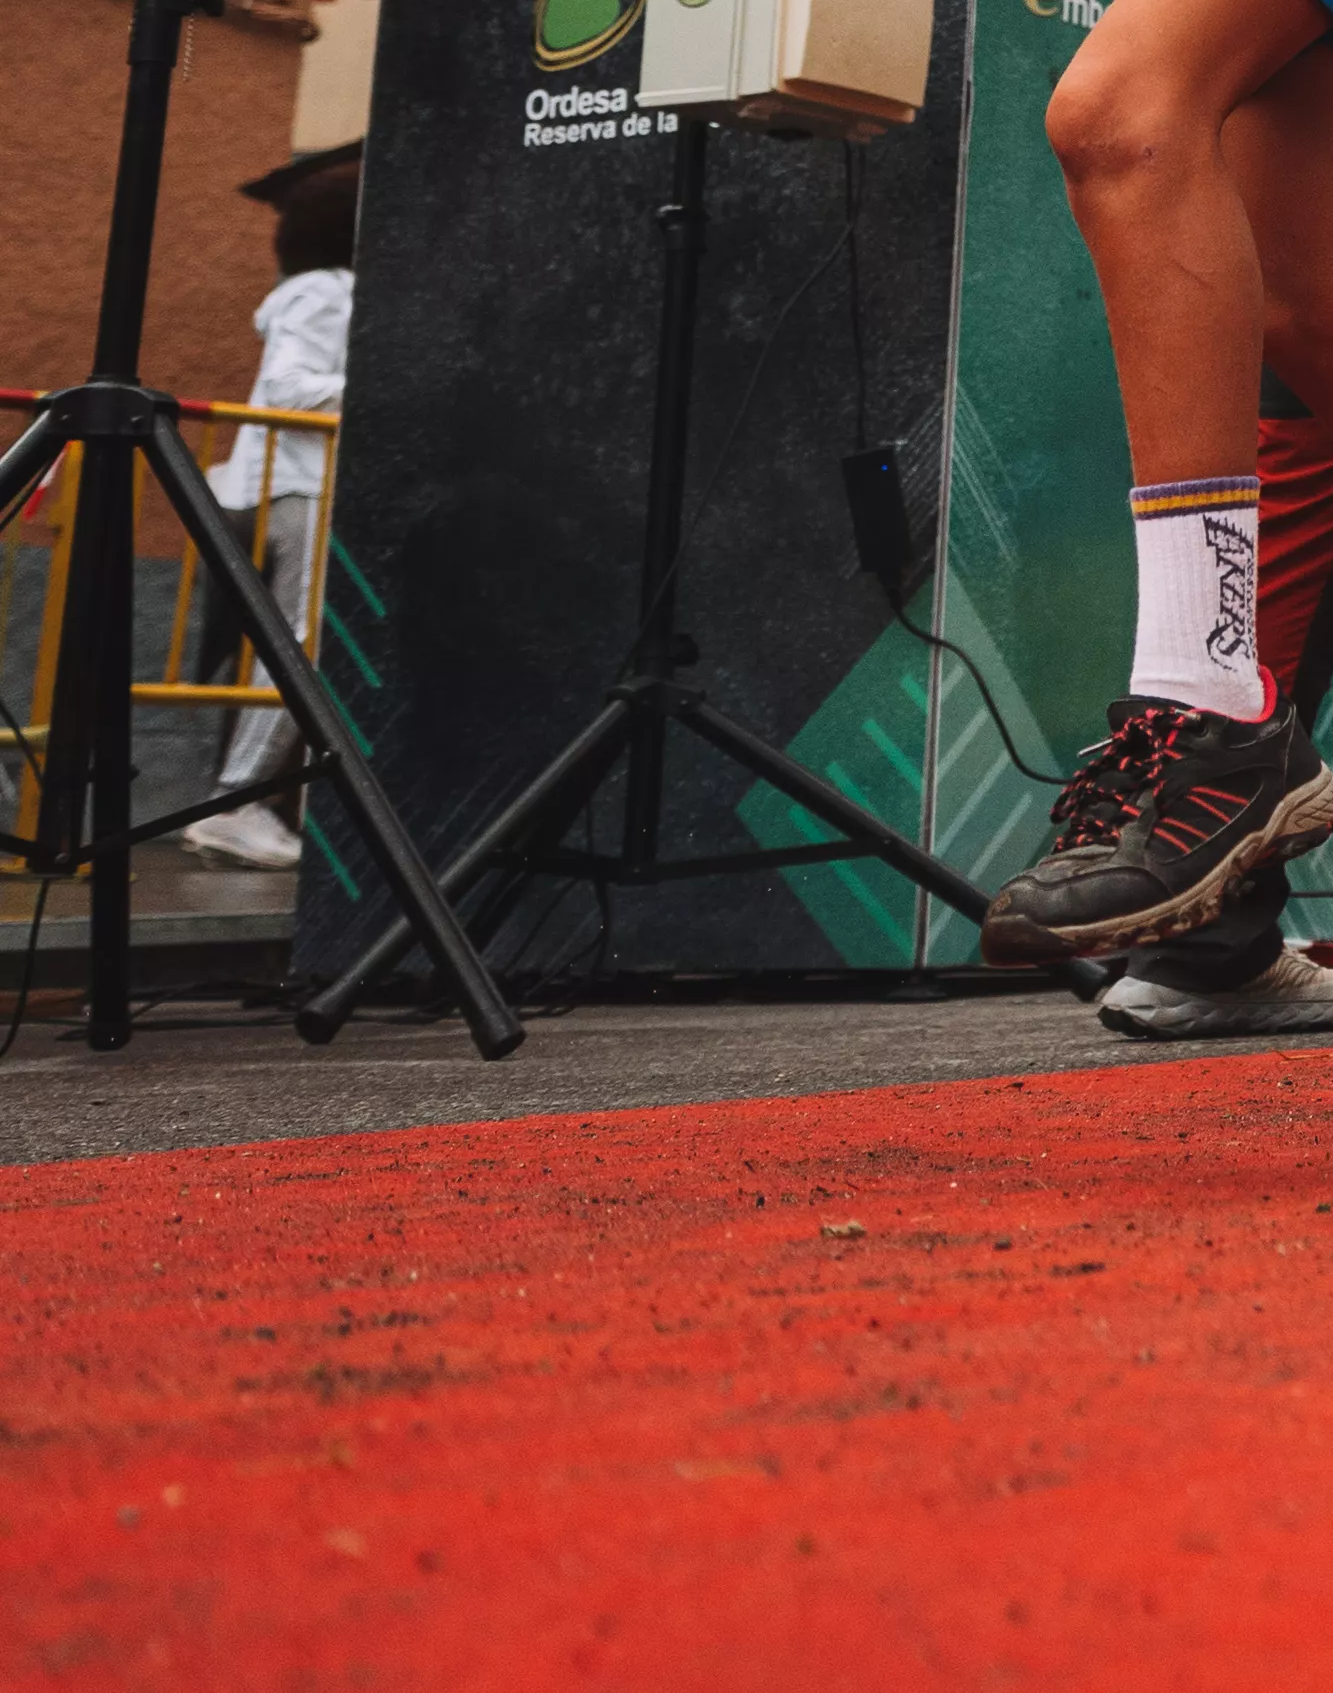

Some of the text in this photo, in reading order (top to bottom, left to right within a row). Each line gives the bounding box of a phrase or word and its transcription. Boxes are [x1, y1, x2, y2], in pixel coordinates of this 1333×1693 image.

[525, 85, 628, 121] Ordesa
[524, 111, 678, 147] Reserva de la
[1202, 514, 1254, 673] LAKERS
